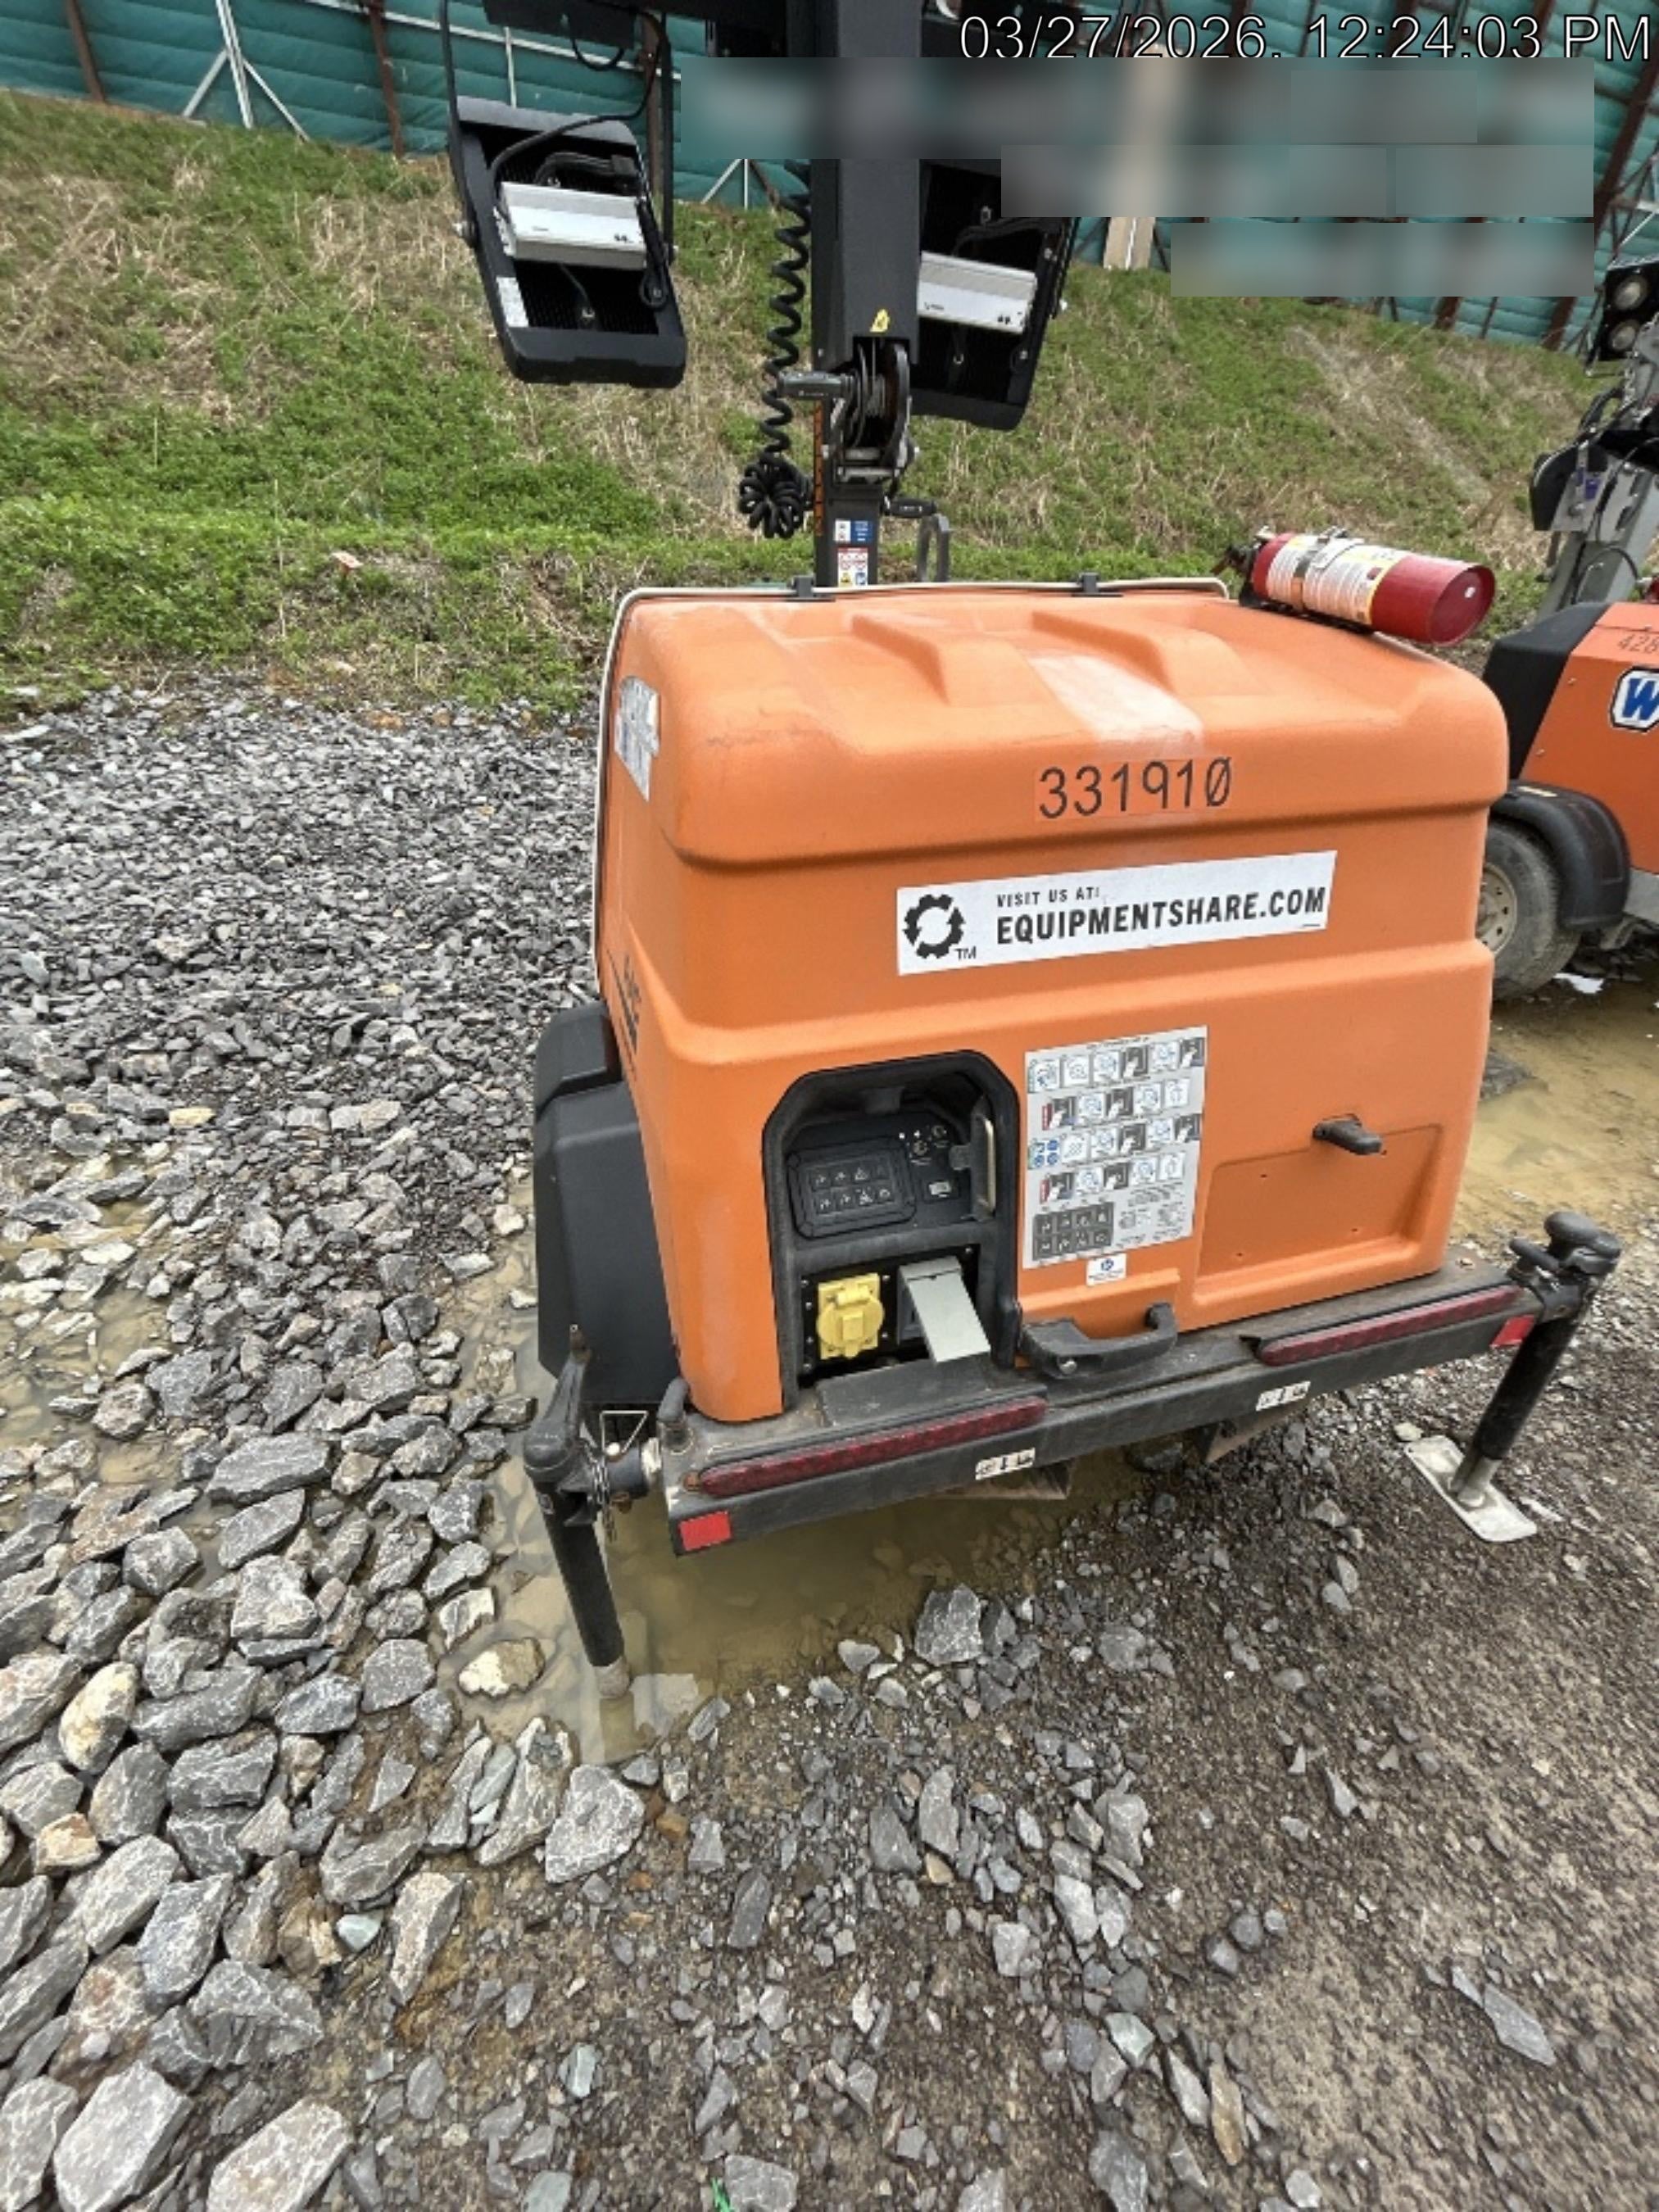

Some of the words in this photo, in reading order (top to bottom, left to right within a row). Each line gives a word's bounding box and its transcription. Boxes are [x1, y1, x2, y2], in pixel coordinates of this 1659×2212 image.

[1040, 757, 1232, 818] 331910
[997, 892, 1040, 908] VISIT
[1049, 889, 1068, 904] US
[997, 887, 1326, 945] EQUIPMENTSHARE.COM
[955, 946, 977, 961] TM
